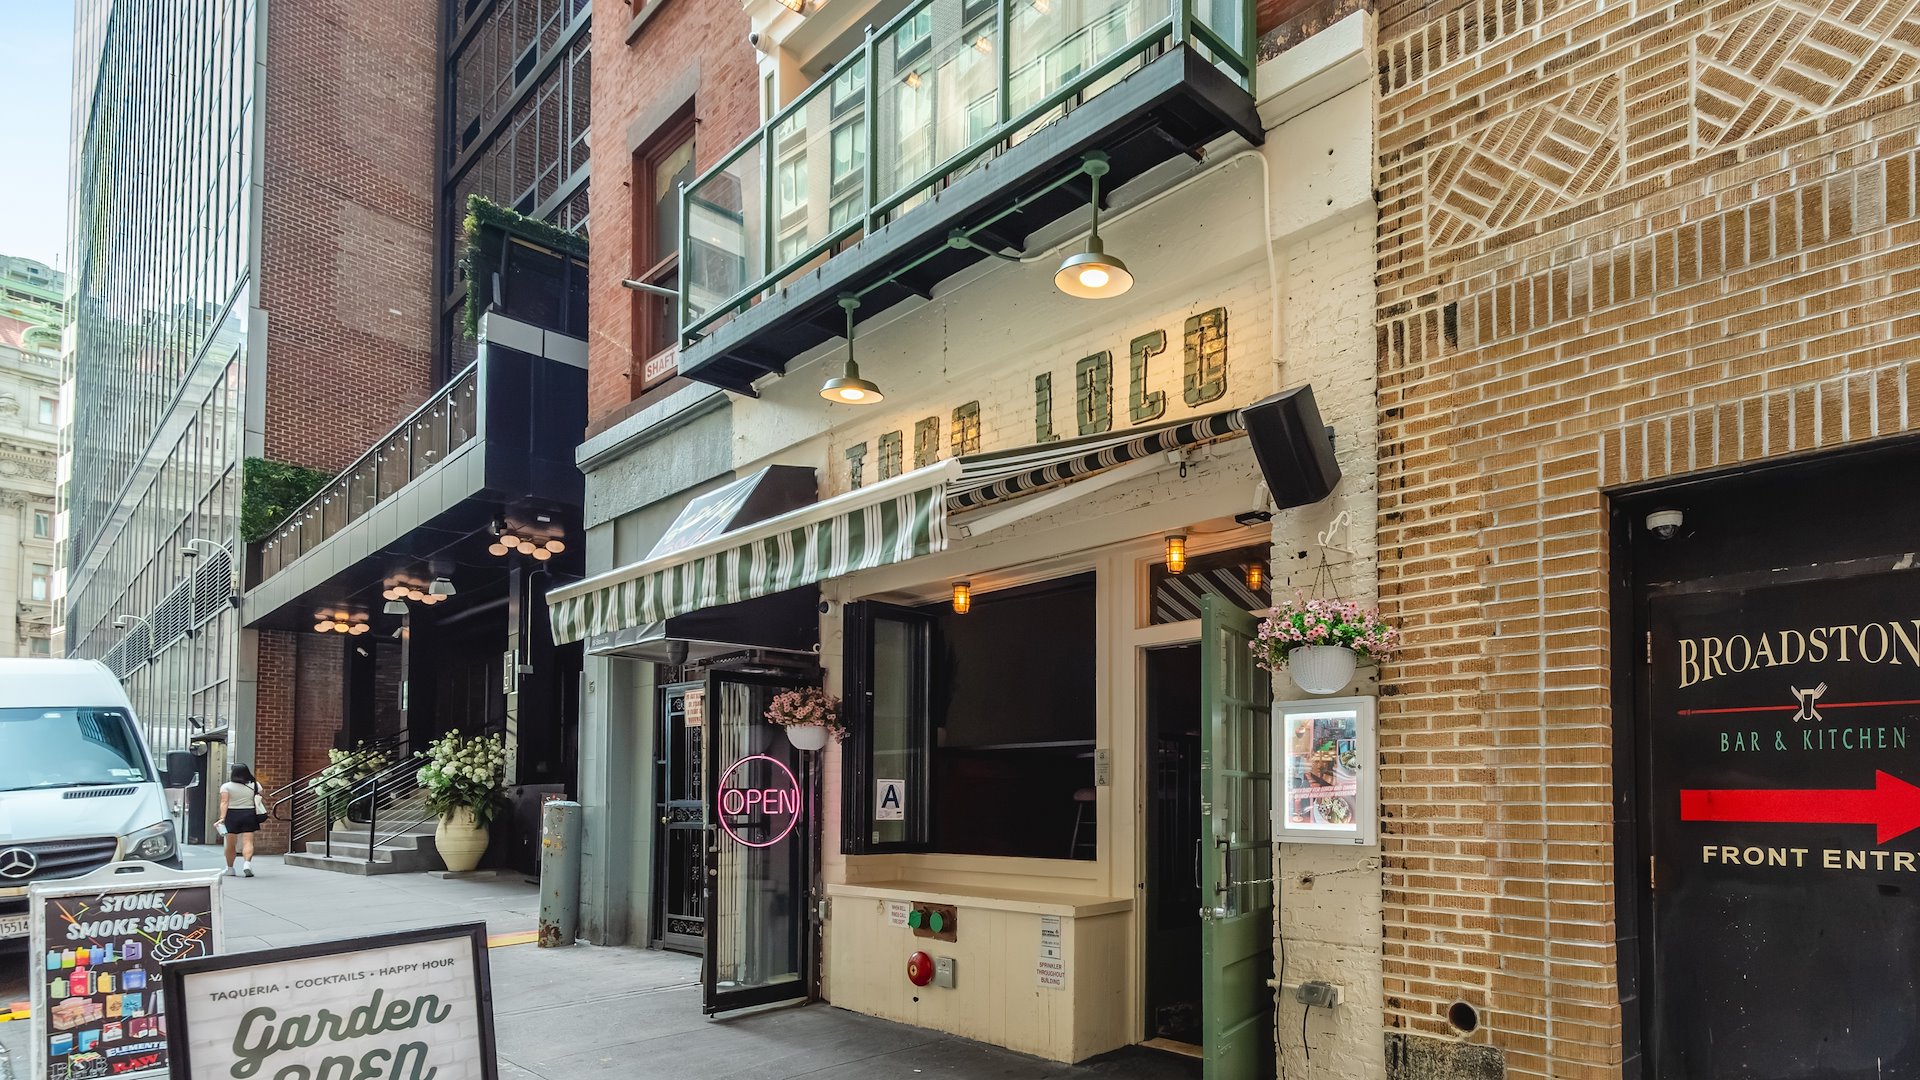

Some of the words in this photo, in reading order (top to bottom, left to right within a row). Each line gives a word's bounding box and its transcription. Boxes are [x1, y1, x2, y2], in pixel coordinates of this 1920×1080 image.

[647, 350, 676, 378] SHAFT
[845, 400, 981, 491] TORO
[1035, 306, 1228, 444] LOCO
[1720, 731, 1761, 752] BAR
[1775, 730, 1787, 751] &
[1803, 727, 1907, 750] KITCHEN
[723, 789, 795, 814] OPEN
[881, 785, 900, 808] A
[1703, 845, 1808, 868] FRONT
[1823, 849, 1920, 872] ENTR
[100, 892, 165, 913] STONE
[66, 917, 140, 940] SMOKE
[143, 913, 197, 933] SHOP
[209, 983, 280, 1002] TAQUERIA
[295, 971, 365, 989] COCKTAILS
[379, 963, 418, 977] HAPPY
[422, 958, 455, 970] HOUR
[1036, 969, 1065, 978] THROUGHOUT
[1041, 977, 1060, 986] BUILDING
[230, 988, 452, 1080] Garden
[112, 1054, 159, 1075] RAW
